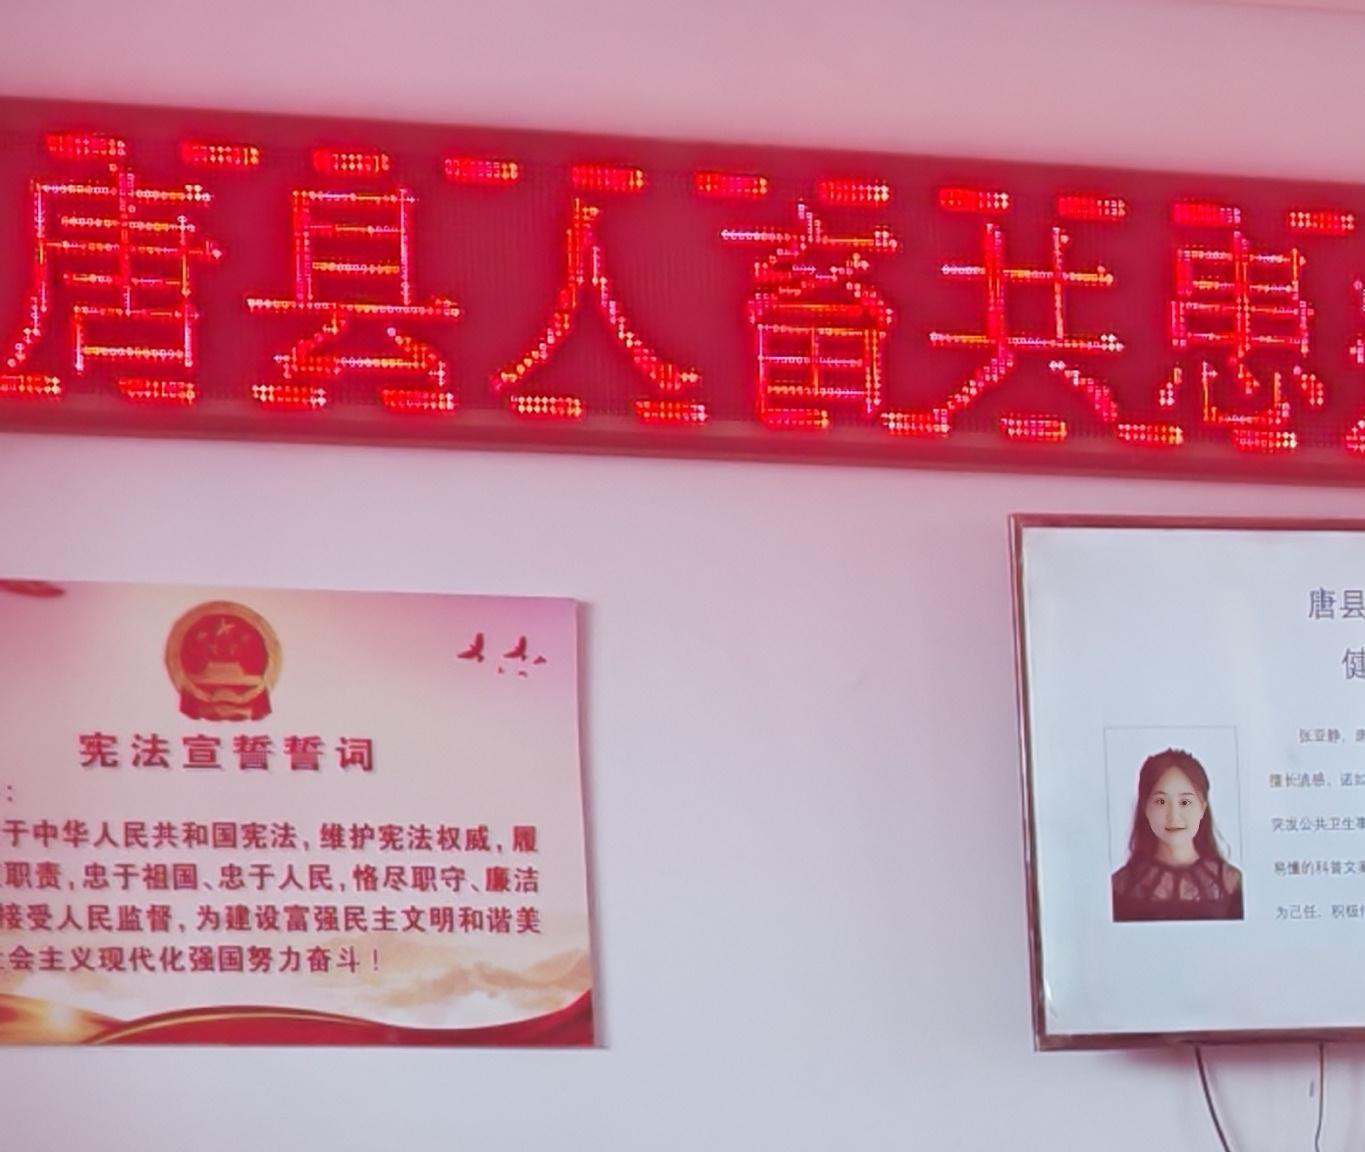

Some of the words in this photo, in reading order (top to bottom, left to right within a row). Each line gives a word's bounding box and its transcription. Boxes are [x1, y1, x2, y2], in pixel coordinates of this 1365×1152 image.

[79, 732, 376, 772] 宪法宣誓誓词
[2, 820, 539, 854] 于中华人民共和国宪法，维护宪法权威，履
[0, 861, 540, 894] 职责，忠于祖国、忠于人民，恪尽职守、廉洁
[0, 902, 542, 936] 接受人民监督，为建设富强民主文明和谐美
[0, 943, 381, 974] 会主义现代化强国努力奋斗！
